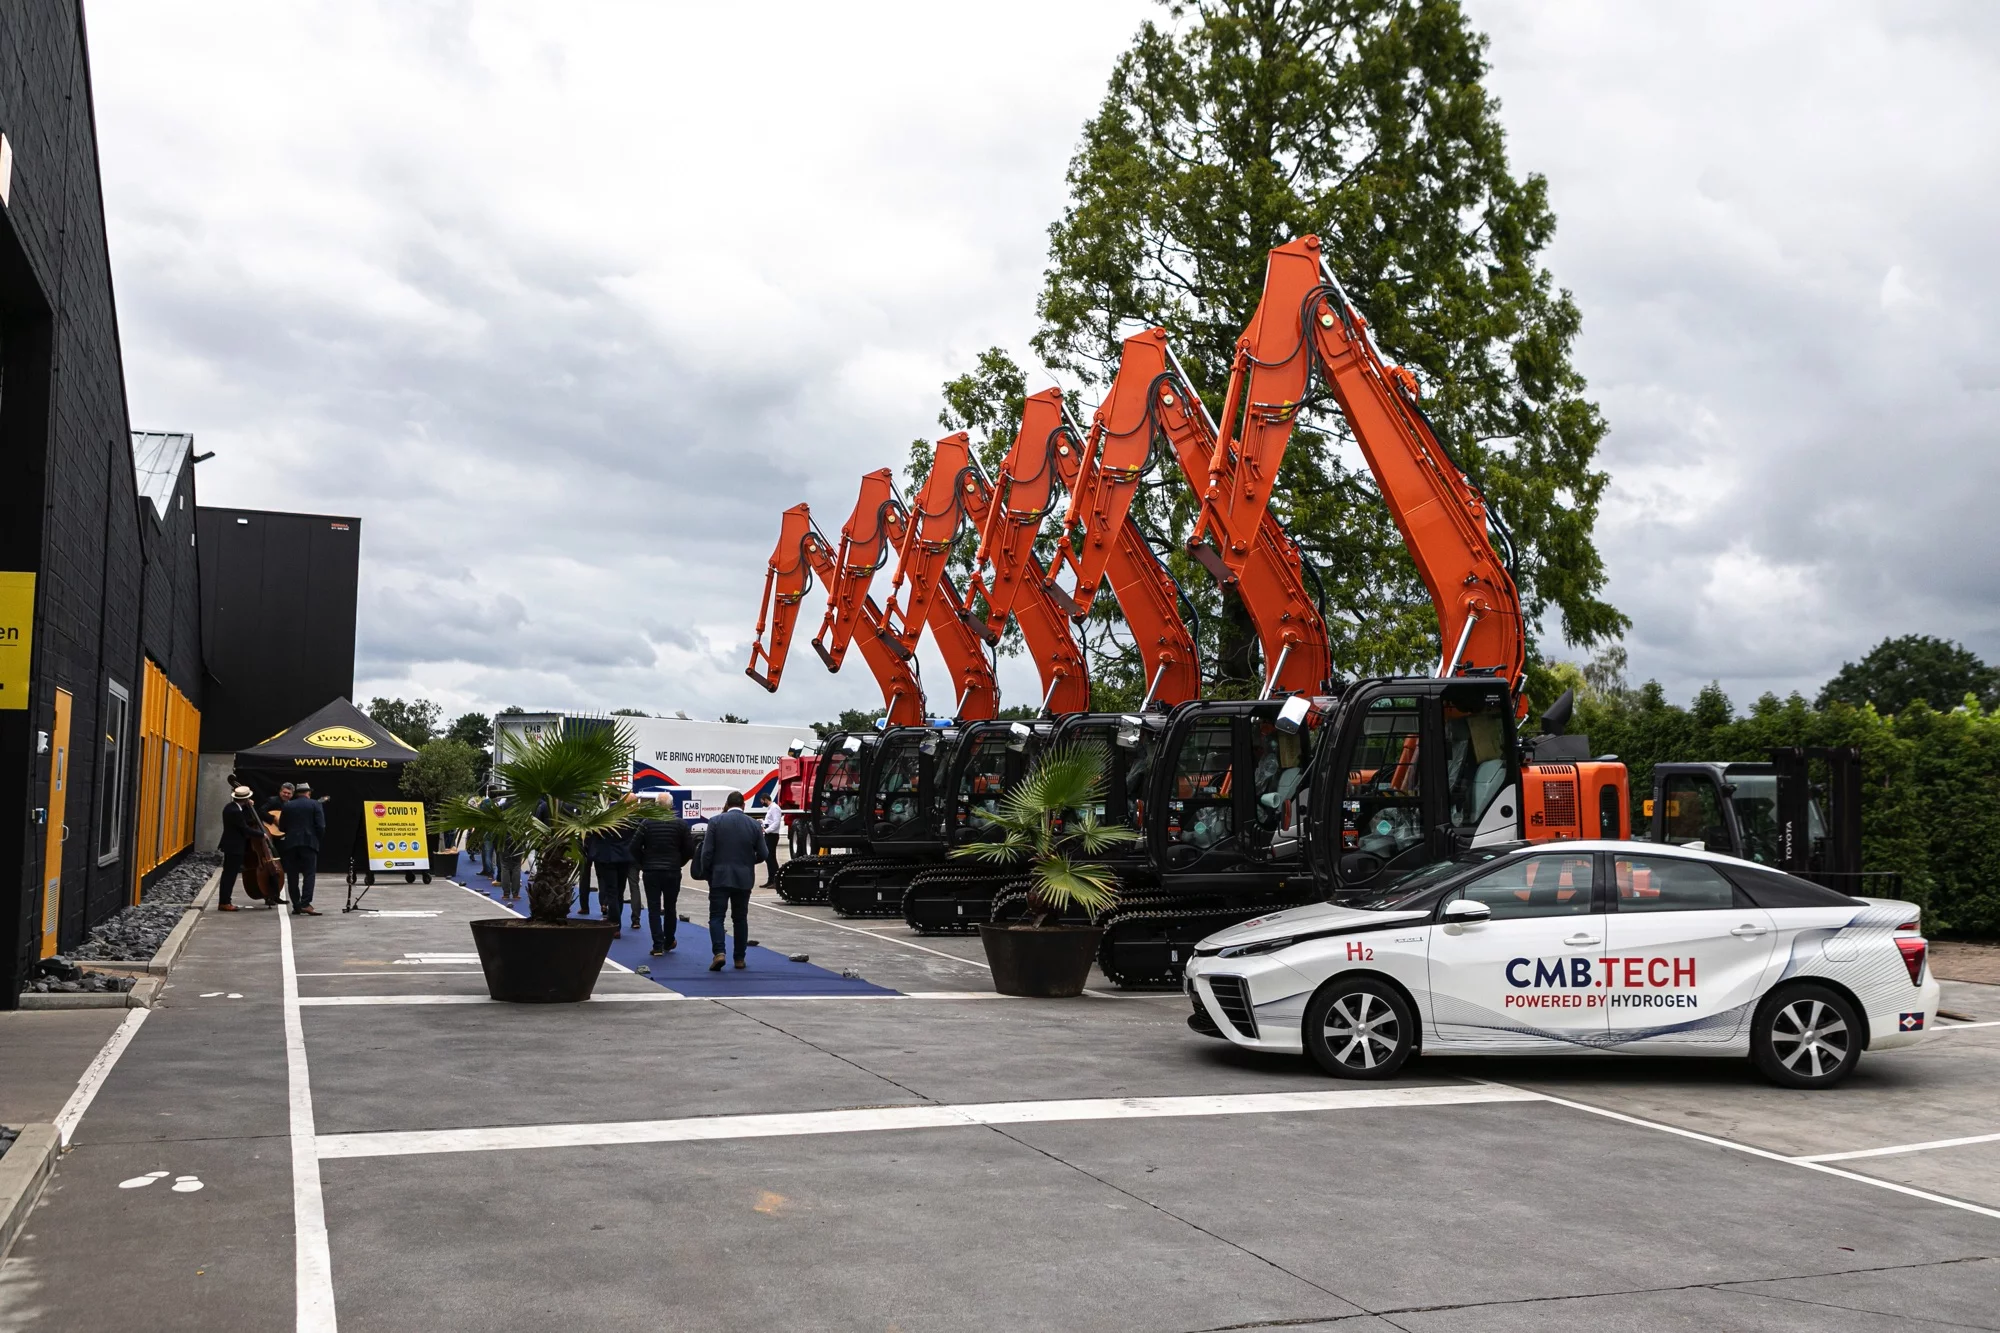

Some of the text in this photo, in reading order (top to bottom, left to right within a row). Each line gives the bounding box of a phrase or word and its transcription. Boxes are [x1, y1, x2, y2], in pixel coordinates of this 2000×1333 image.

[294, 756, 388, 769] www.luyckx.be
[655, 751, 668, 761] WE
[669, 752, 693, 762] BRING
[695, 752, 735, 764] HYDROGEN
[736, 754, 745, 764] TO
[745, 754, 759, 764] THE
[388, 806, 417, 815] COVID 19
[684, 802, 699, 810] CMB
[1785, 820, 1793, 860] TOYOTA
[1346, 941, 1374, 961] H2
[1505, 957, 1696, 988] CMB.TECH
[1505, 994, 1697, 1008] POWERED BY HYDROGEN
